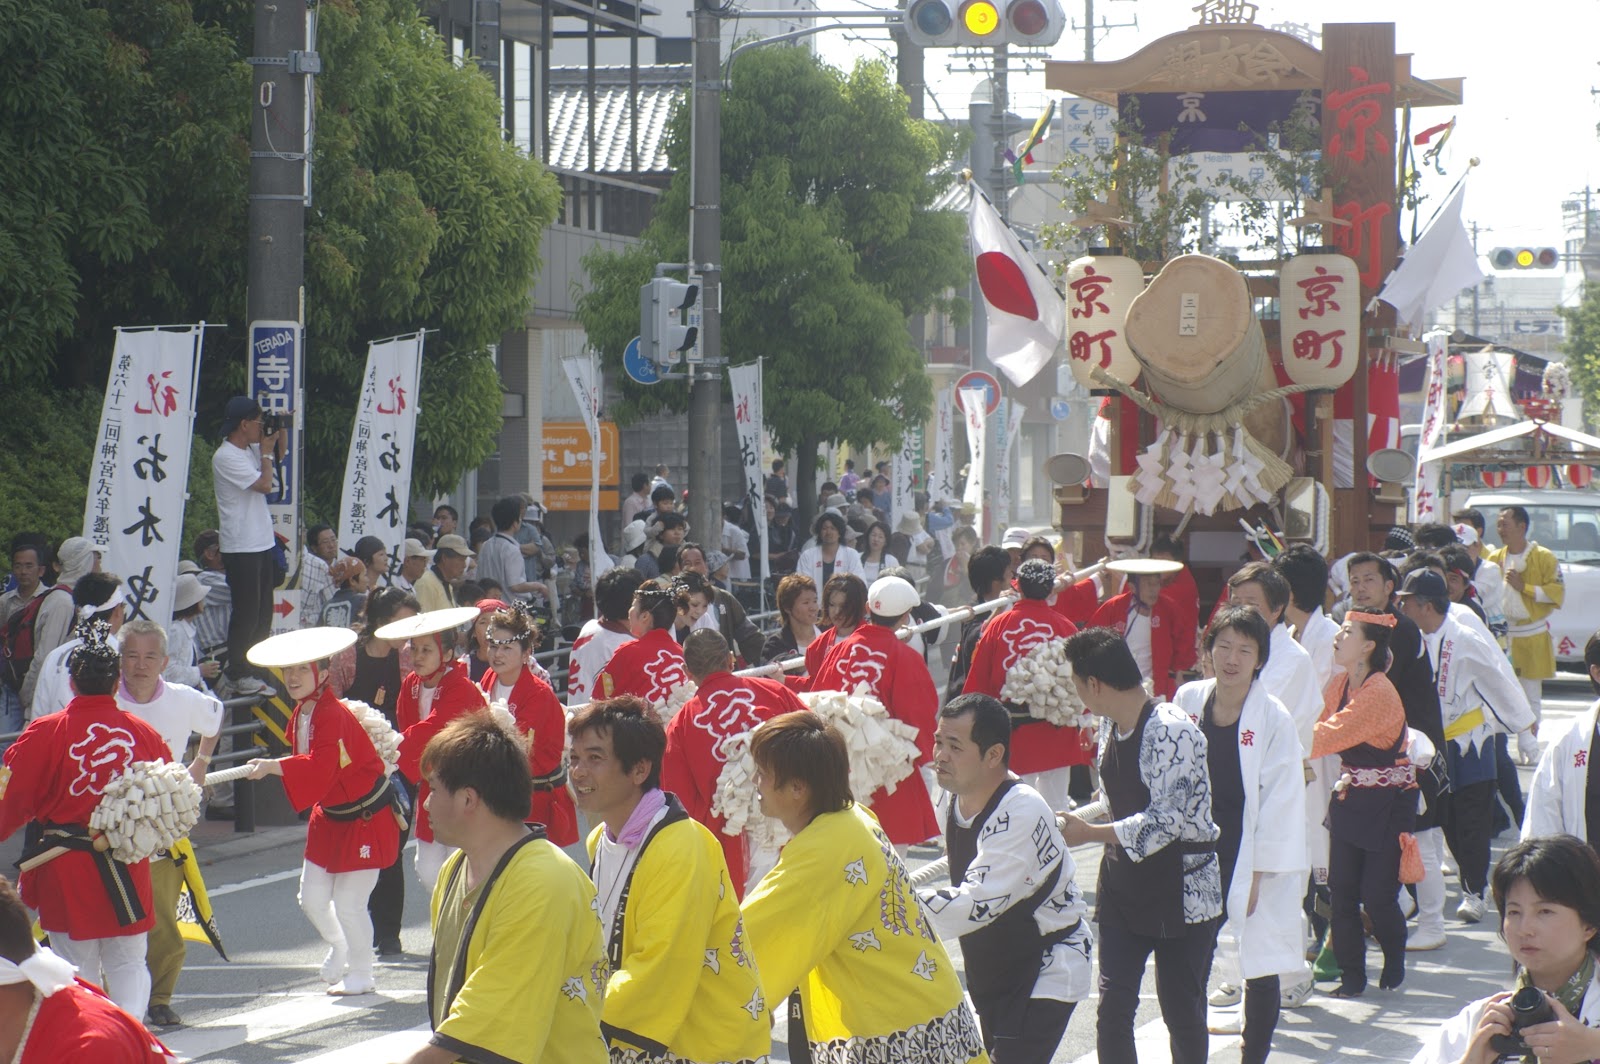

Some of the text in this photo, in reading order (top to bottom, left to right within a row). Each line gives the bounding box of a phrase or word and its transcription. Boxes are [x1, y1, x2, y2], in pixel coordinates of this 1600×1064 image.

[1177, 92, 1207, 122] 京
[1326, 66, 1391, 289] 京町
[1070, 266, 1117, 370] 京町
[1182, 298, 1196, 334] 三二六
[1293, 266, 1346, 369] 京町
[254, 330, 294, 355] TERADA
[1240, 729, 1256, 747] 京
[1573, 750, 1588, 768] 京
